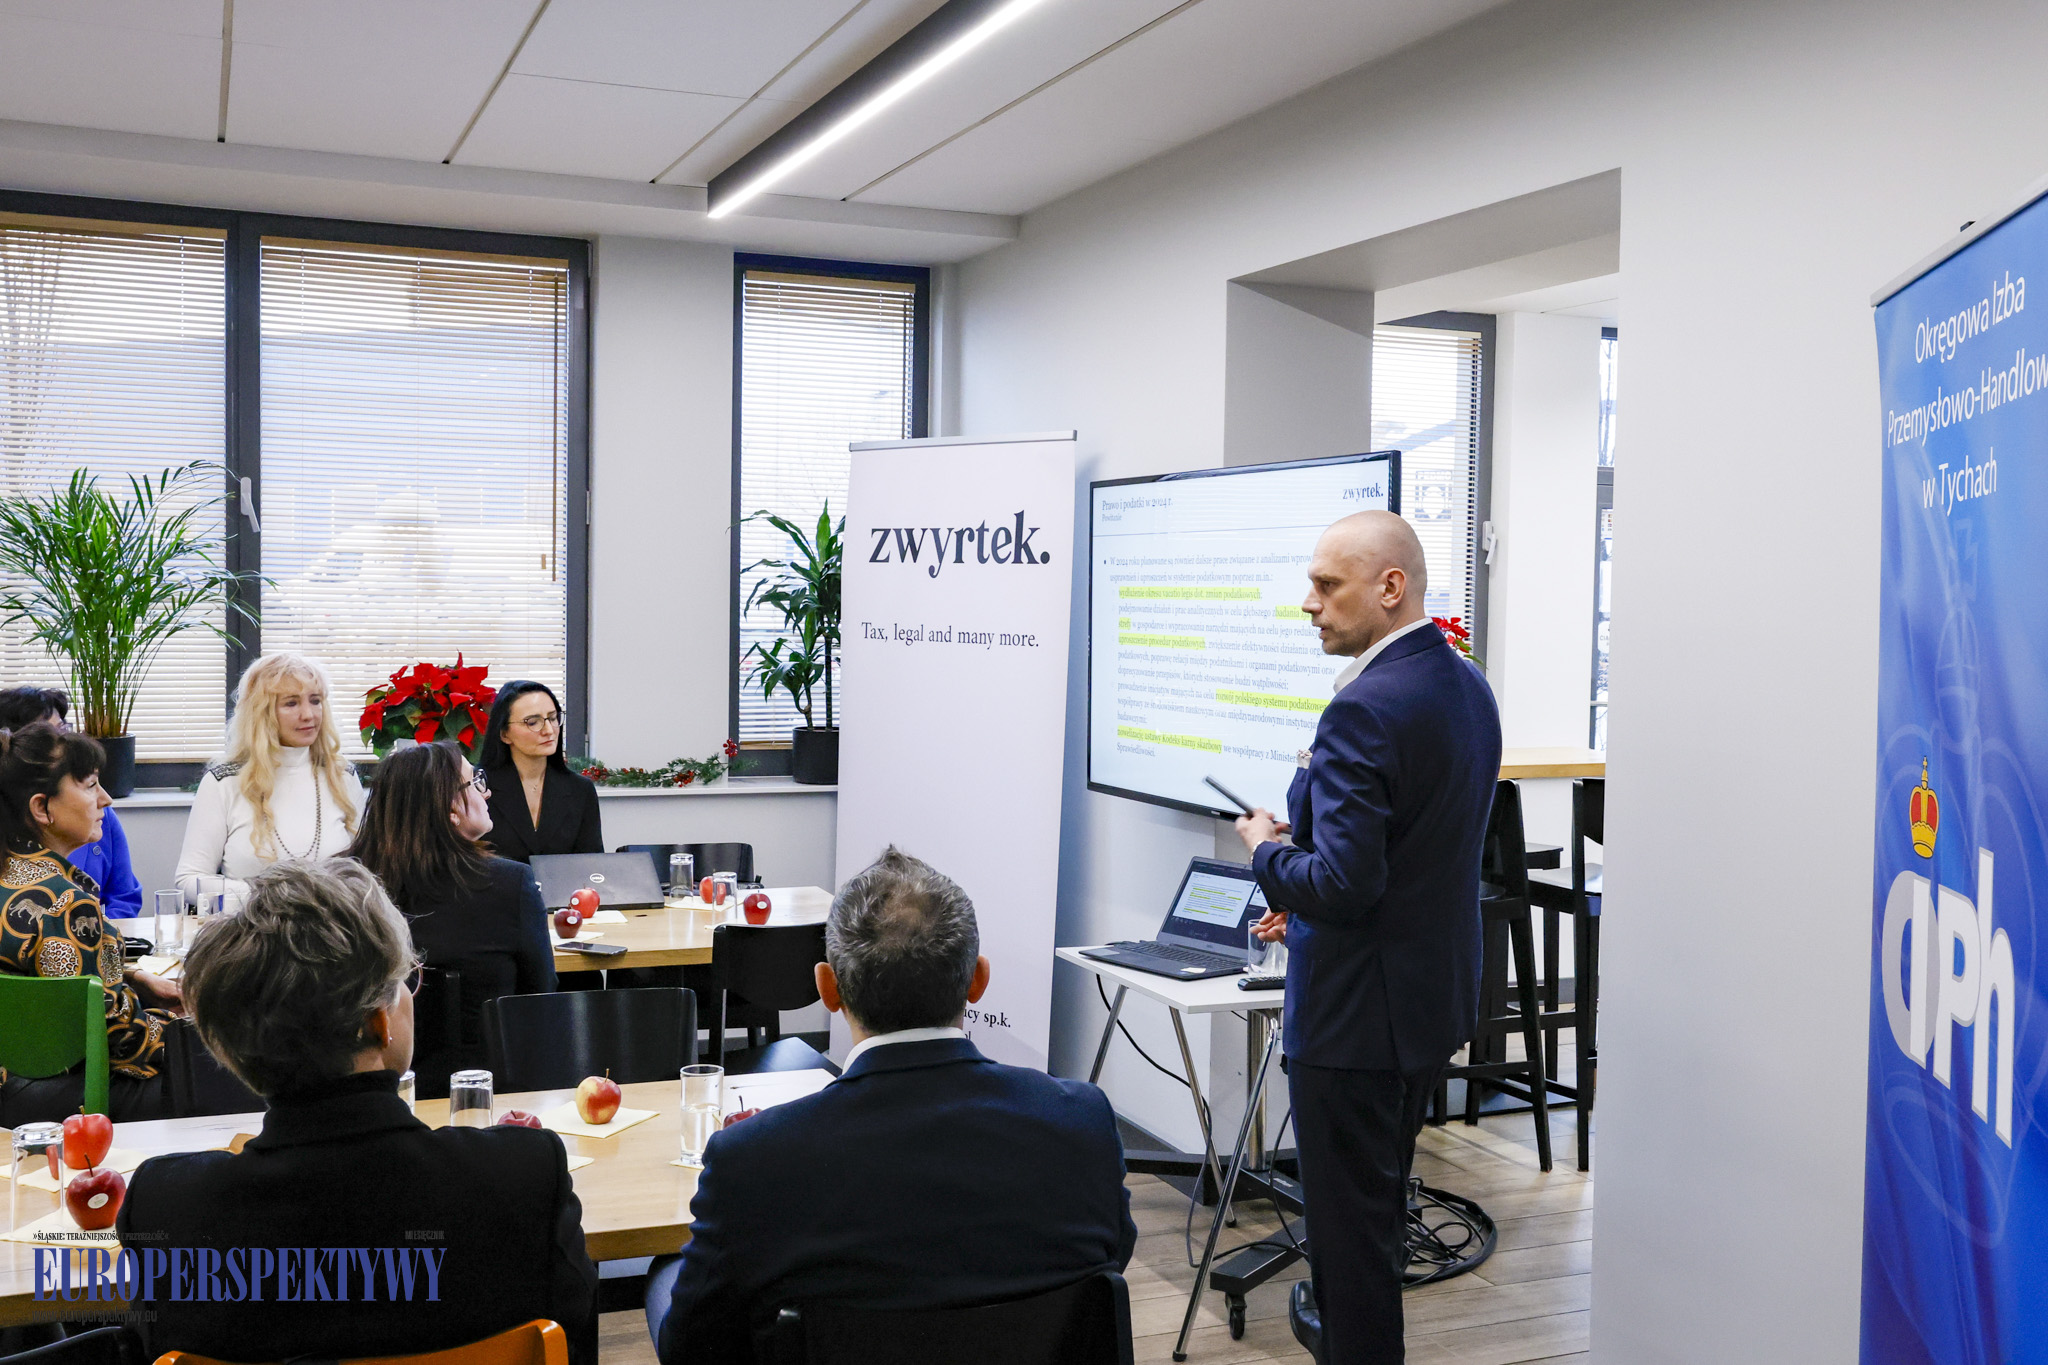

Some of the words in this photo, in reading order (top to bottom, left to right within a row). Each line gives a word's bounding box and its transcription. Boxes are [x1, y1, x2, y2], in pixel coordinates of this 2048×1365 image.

[1915, 297, 1989, 363] Okręgowa
[1992, 270, 2025, 325] Izba
[1888, 348, 2048, 448] Przemysłowo-Handlow
[1922, 477, 1936, 509] w
[1938, 446, 1997, 517] Tychach
[1343, 482, 1384, 502] zwyrtek.
[1102, 499, 1118, 511] Prawo
[1123, 496, 1144, 512] podatki
[1152, 498, 1167, 508] 2024
[869, 509, 1051, 578] zwyrtek.
[1260, 552, 1289, 564] analizami
[1196, 571, 1231, 584] podatkowym
[1232, 573, 1254, 584] poprzez
[861, 622, 888, 643] Tax,
[894, 623, 924, 645] legal
[929, 625, 952, 643] and
[957, 631, 994, 650] many
[999, 631, 1039, 647] more.
[1249, 660, 1276, 672] organami
[1278, 661, 1320, 676] podatkowymi
[1321, 666, 1335, 675] oraz
[1216, 690, 1234, 704] rozwój
[1235, 692, 1262, 707] polskiego
[1263, 696, 1288, 708] systemu
[1228, 708, 1285, 727] międzynarodowymi
[1181, 735, 1196, 750] karny
[1197, 738, 1222, 754] skarbowy
[1232, 746, 1264, 760] współpracy
[984, 1012, 1011, 1028] sp.k.
